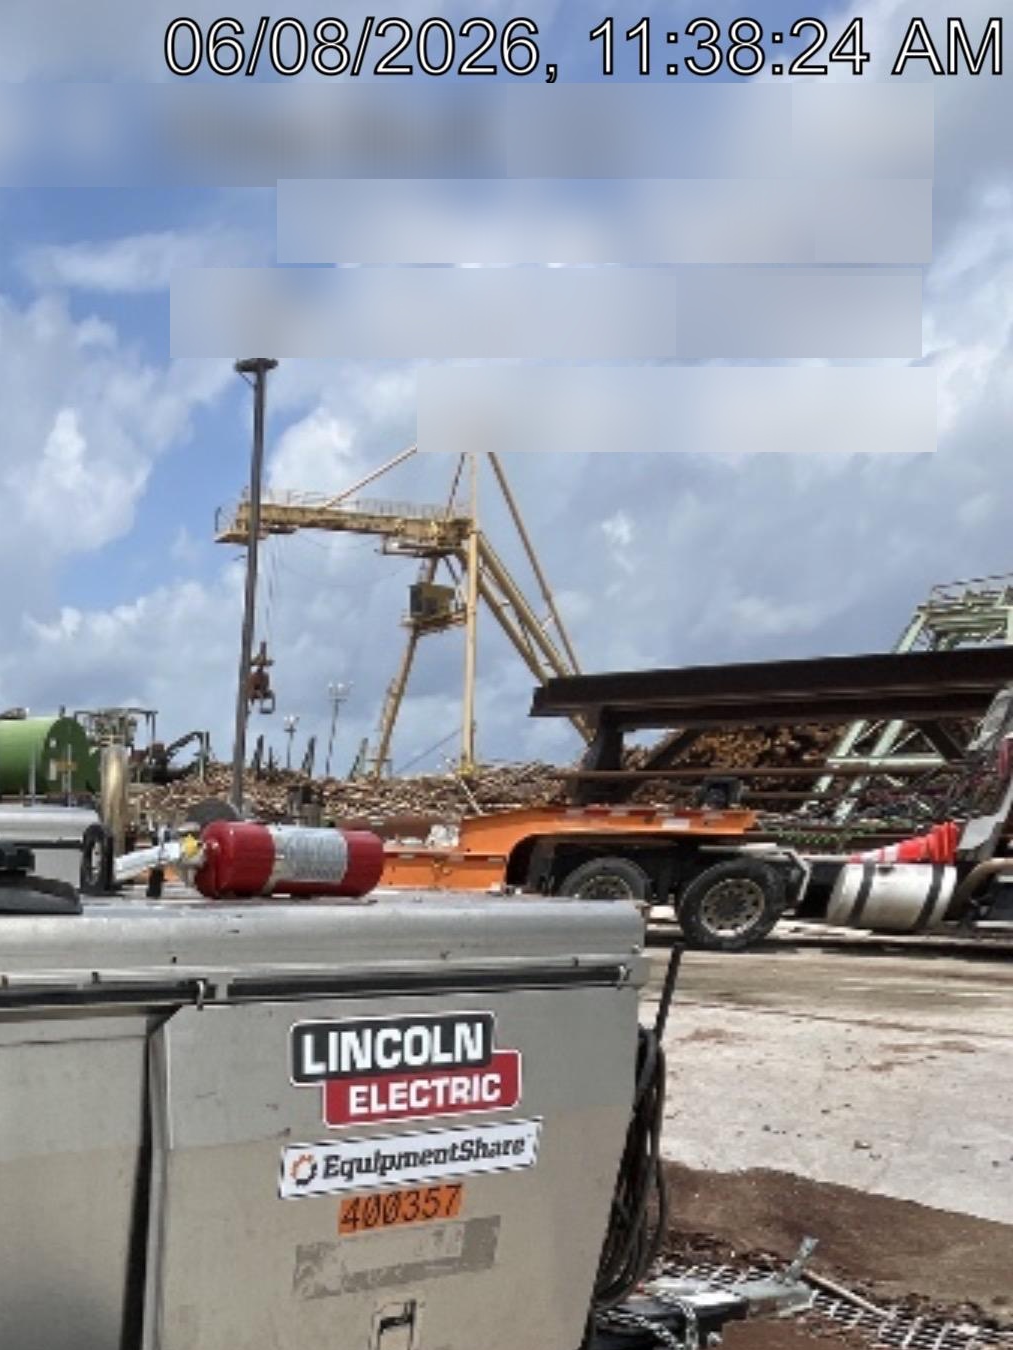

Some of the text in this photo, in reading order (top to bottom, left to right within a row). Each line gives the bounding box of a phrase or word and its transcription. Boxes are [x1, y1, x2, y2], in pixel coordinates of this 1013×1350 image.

[302, 1022, 484, 1075] LINCOLN
[348, 1073, 502, 1117] ELECTRIC
[323, 1136, 525, 1180] EquipmentShare
[340, 1184, 462, 1230] 400357
